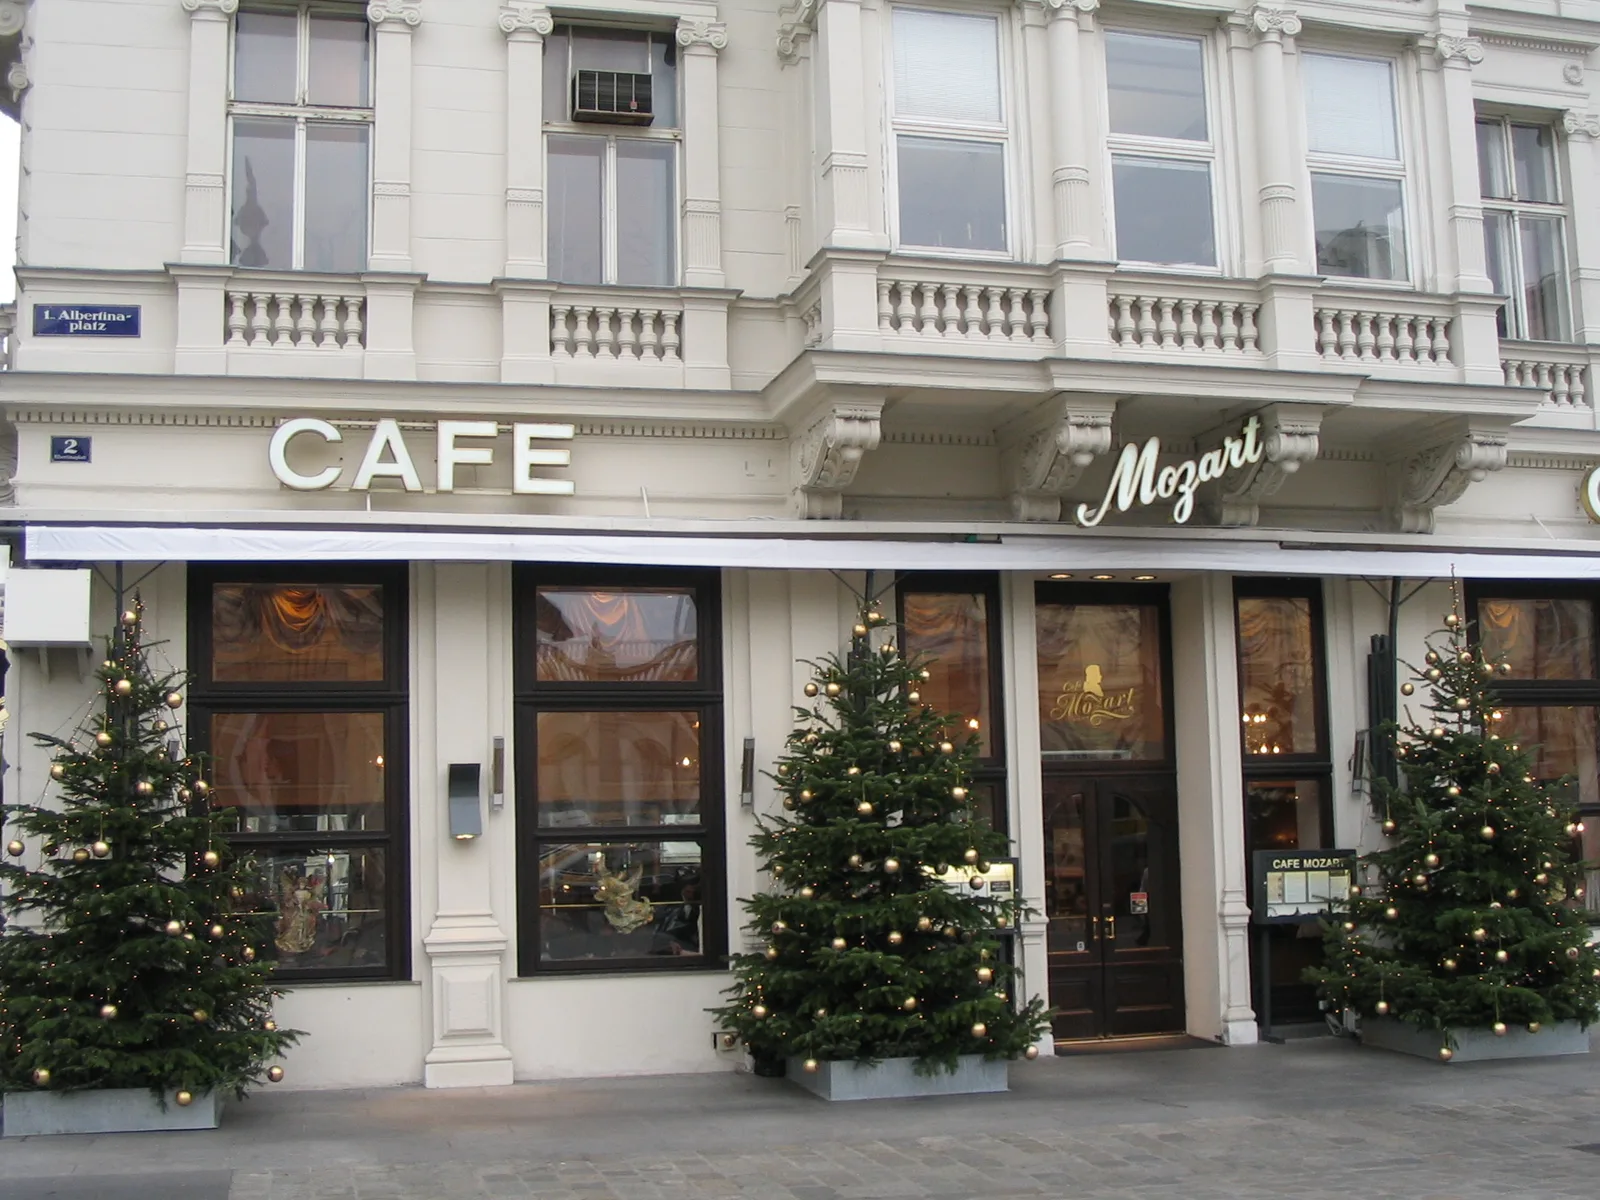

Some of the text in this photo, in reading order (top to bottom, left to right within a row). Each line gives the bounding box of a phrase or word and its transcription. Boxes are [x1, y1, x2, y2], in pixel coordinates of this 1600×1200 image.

[58, 310, 132, 321] Albertina-
[69, 321, 107, 333] platz
[63, 438, 78, 454] 2
[268, 417, 575, 495] CAFE
[1075, 415, 1264, 527] Mozart
[1050, 687, 1135, 726] Mozart
[1272, 859, 1300, 869] CAFE
